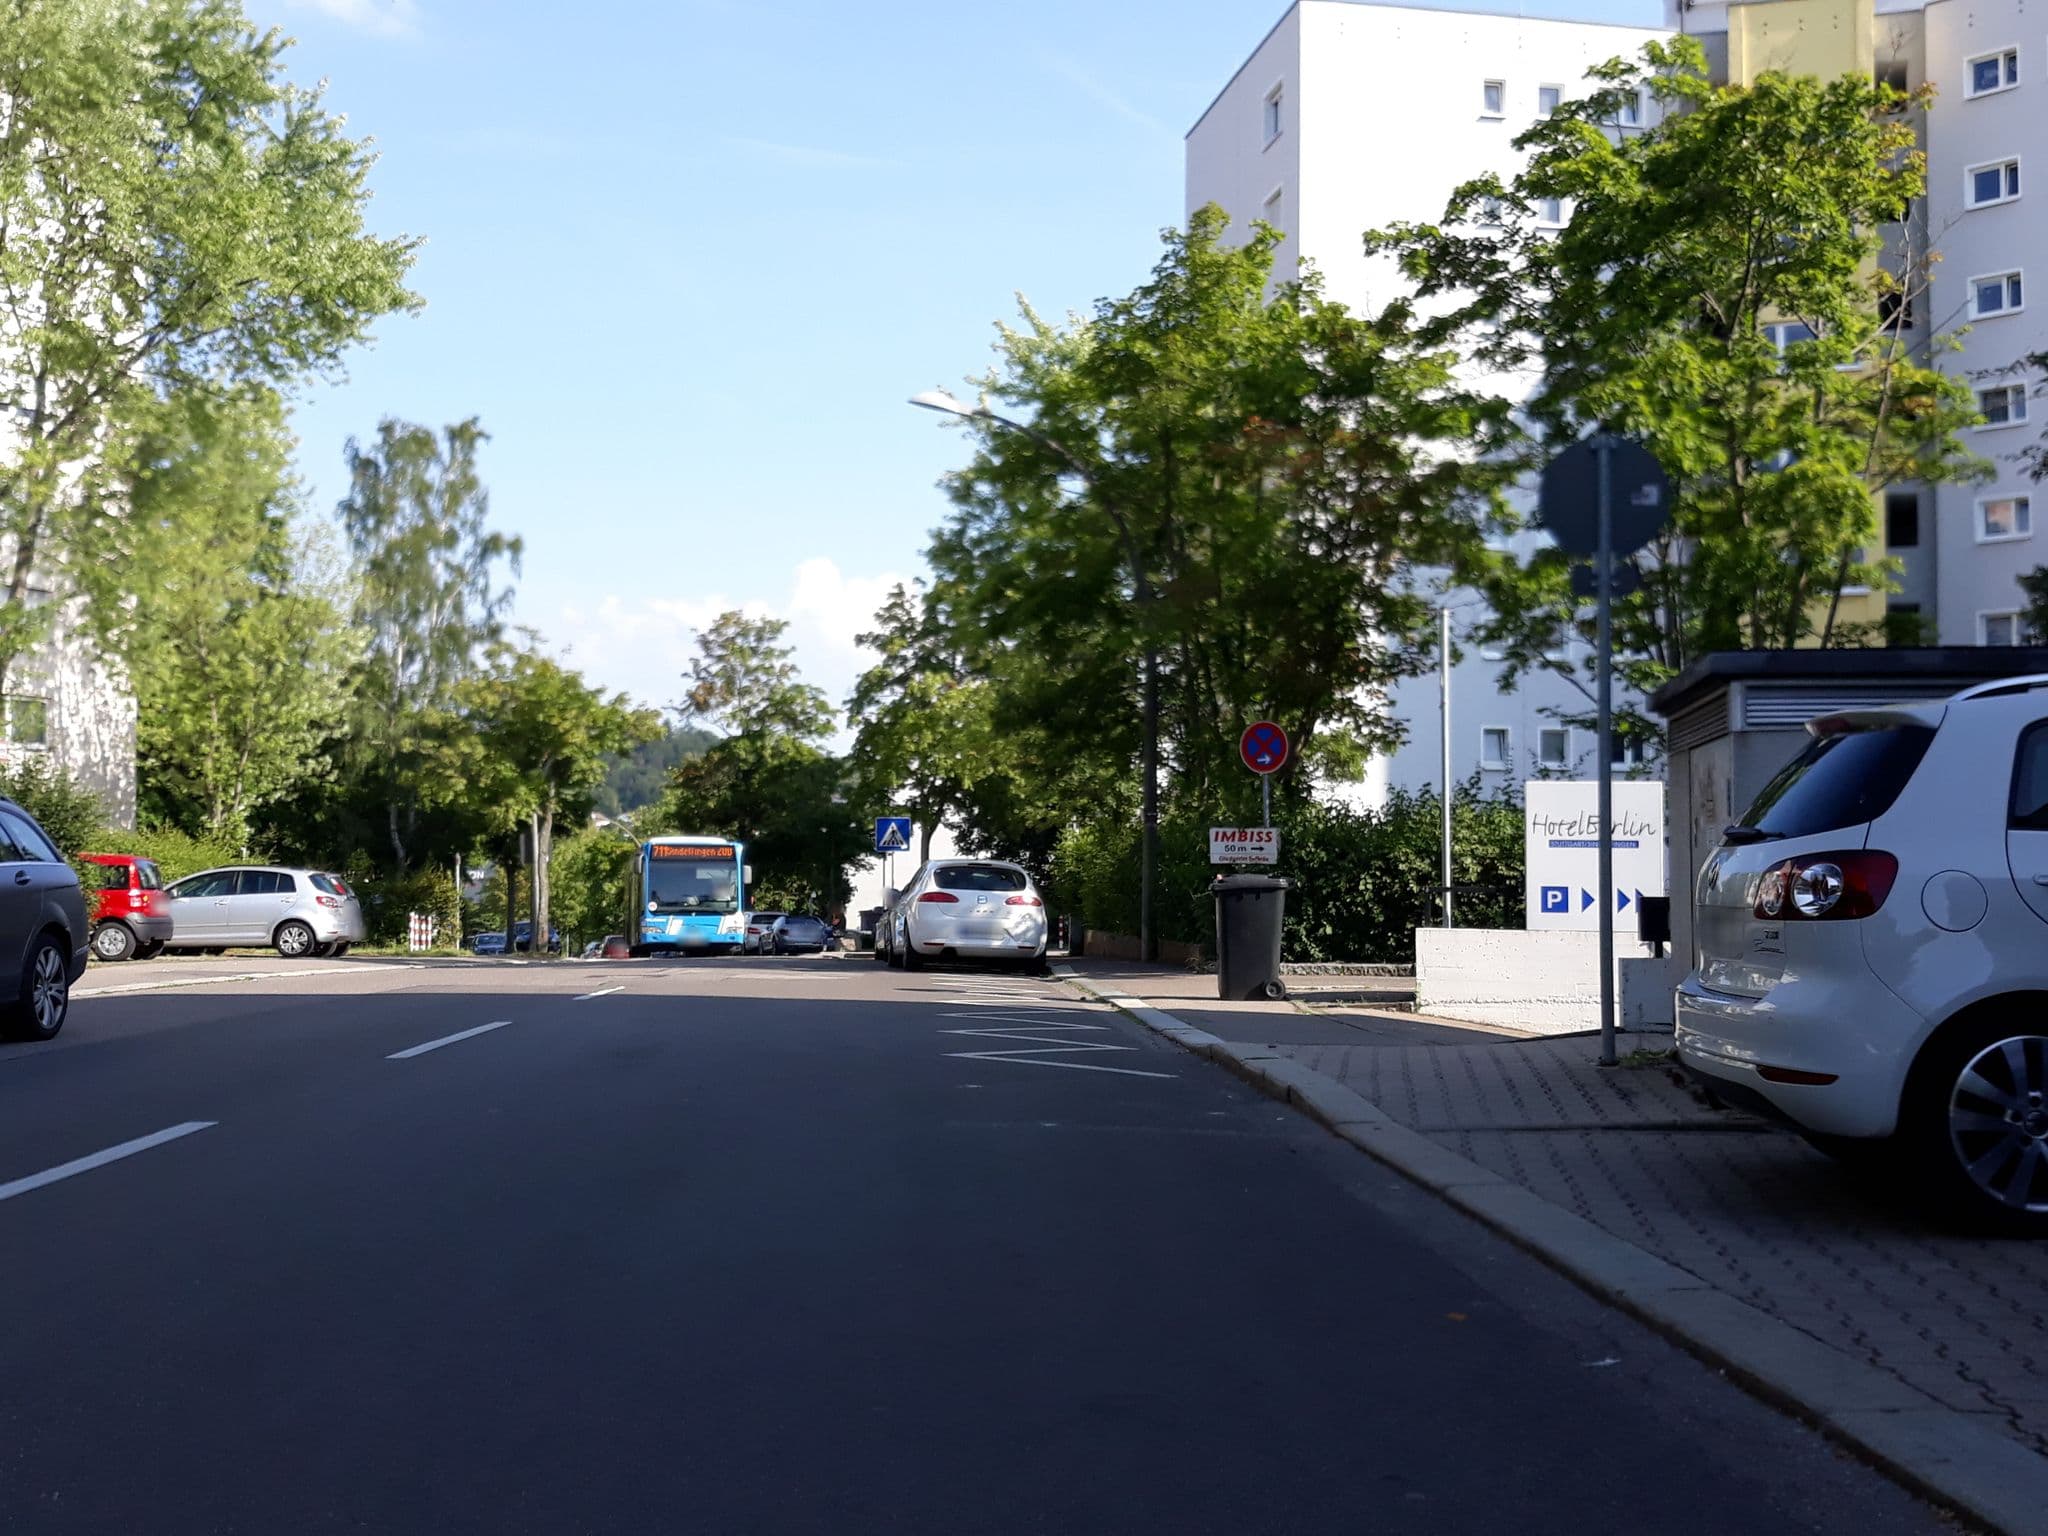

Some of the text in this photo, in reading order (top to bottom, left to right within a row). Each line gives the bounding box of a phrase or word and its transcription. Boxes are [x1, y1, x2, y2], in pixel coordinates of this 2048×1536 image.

[1532, 810, 1656, 836] HotelBrlin
[1214, 831, 1273, 842] IMBISS
[1547, 891, 1562, 909] P
